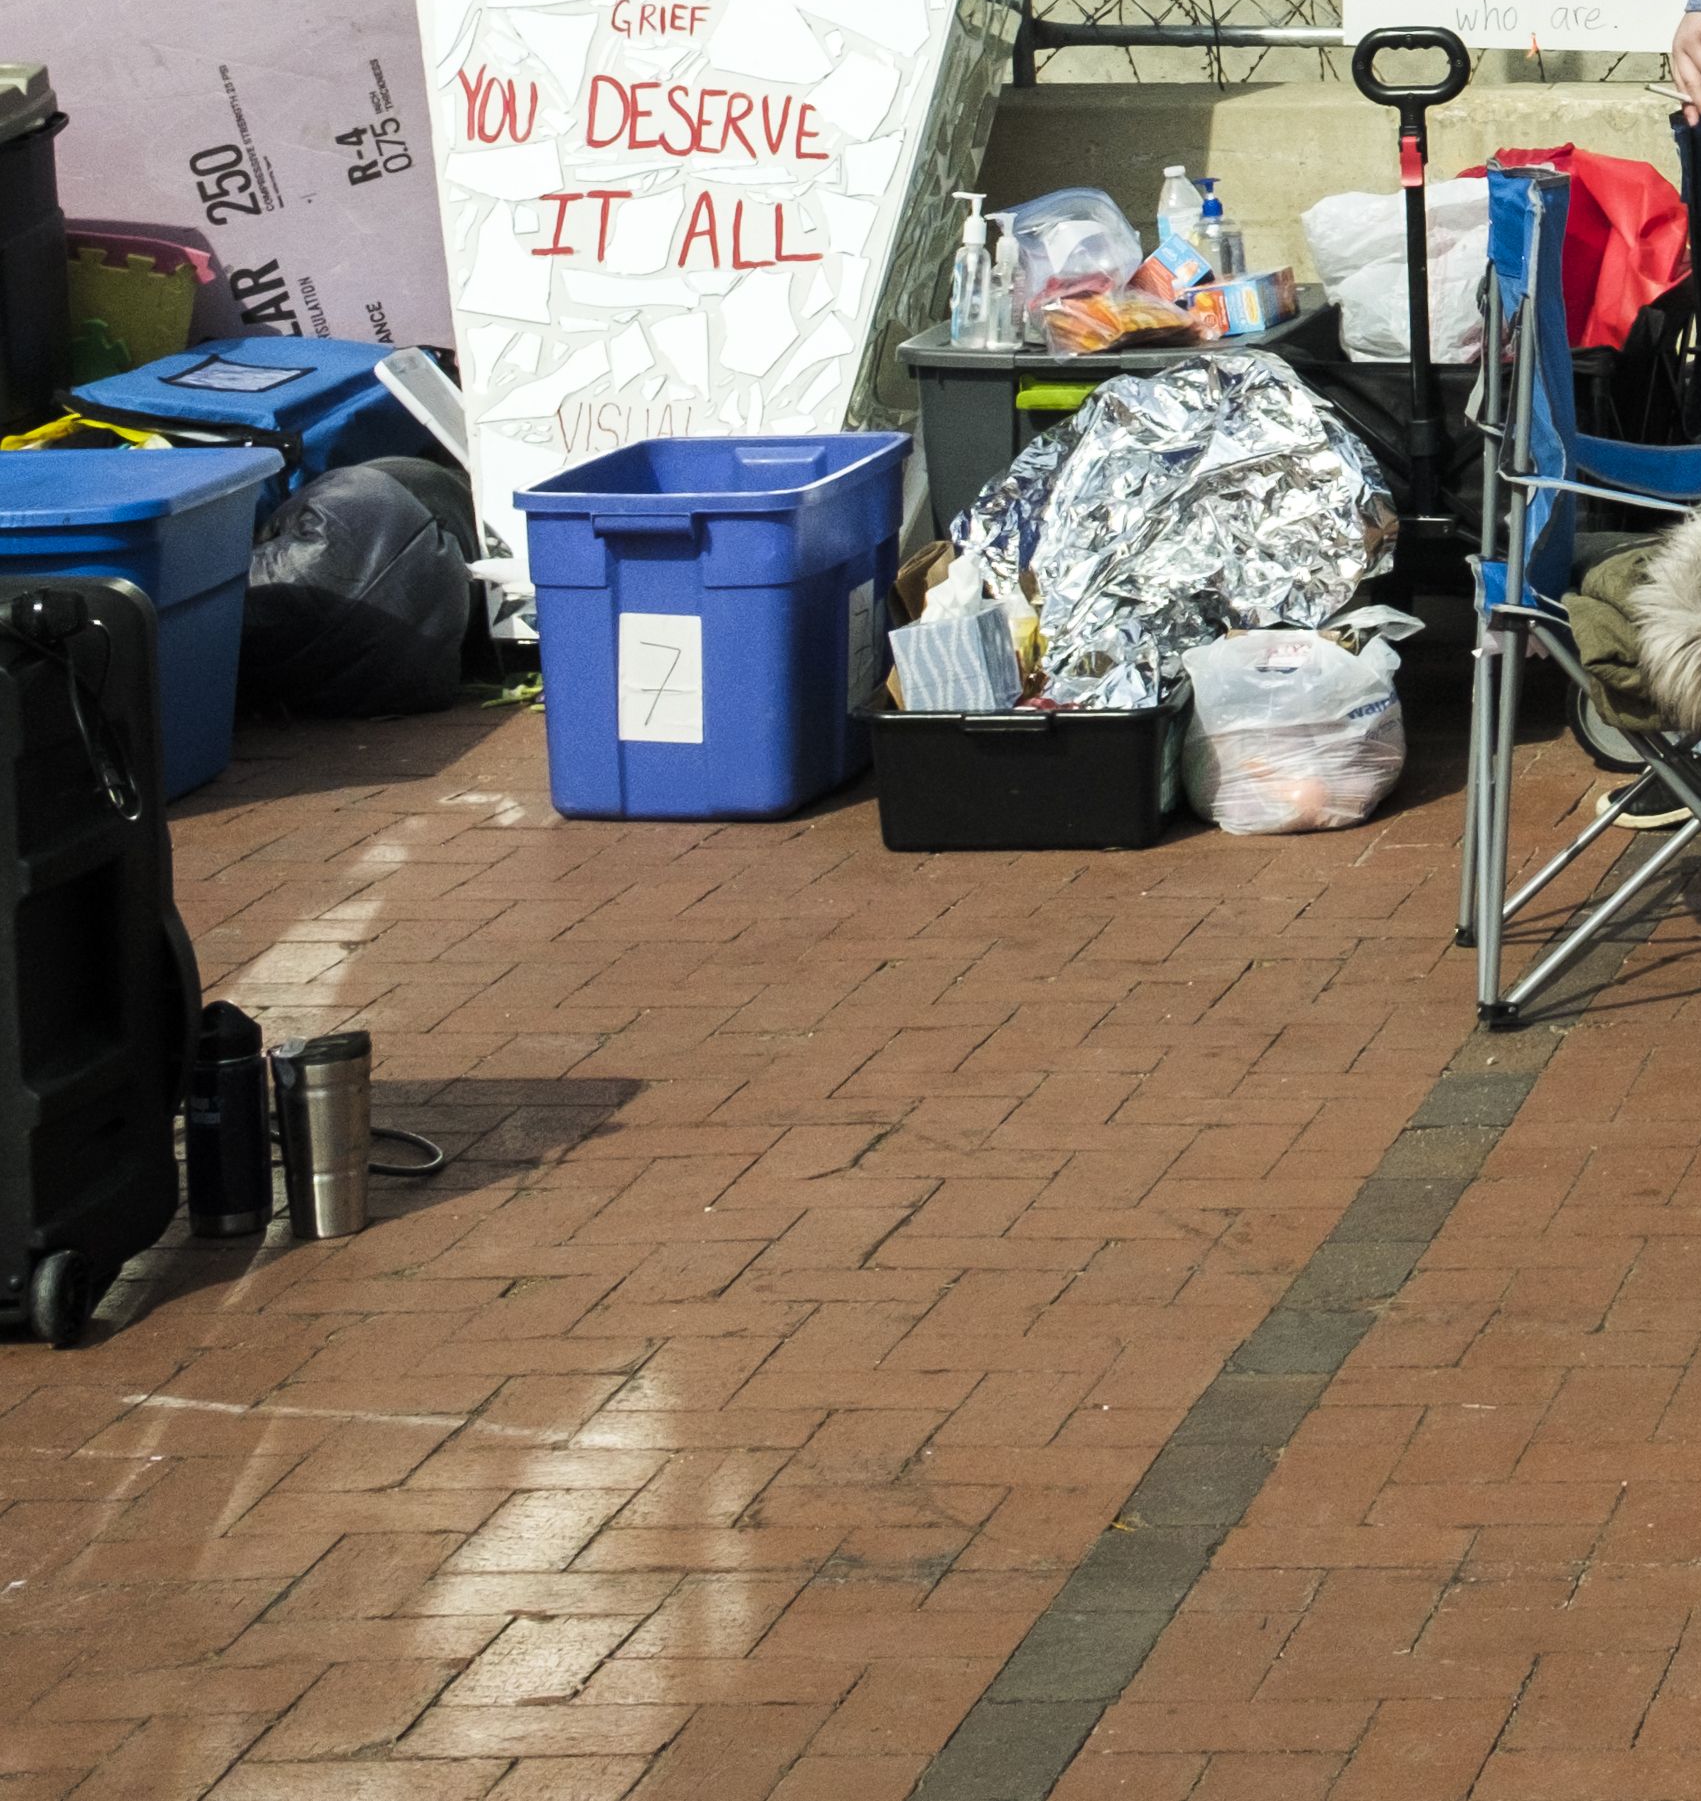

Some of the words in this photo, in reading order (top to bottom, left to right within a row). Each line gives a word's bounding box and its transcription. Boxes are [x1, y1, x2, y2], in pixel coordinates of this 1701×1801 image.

[1550, 5, 1619, 30] are.
[457, 63, 539, 144] YOU
[584, 75, 830, 159] DESERVE
[189, 144, 262, 226] 250
[334, 126, 382, 186] R-4
[532, 191, 632, 262] IT
[678, 191, 823, 270] ALL
[638, 640, 682, 728] 7
